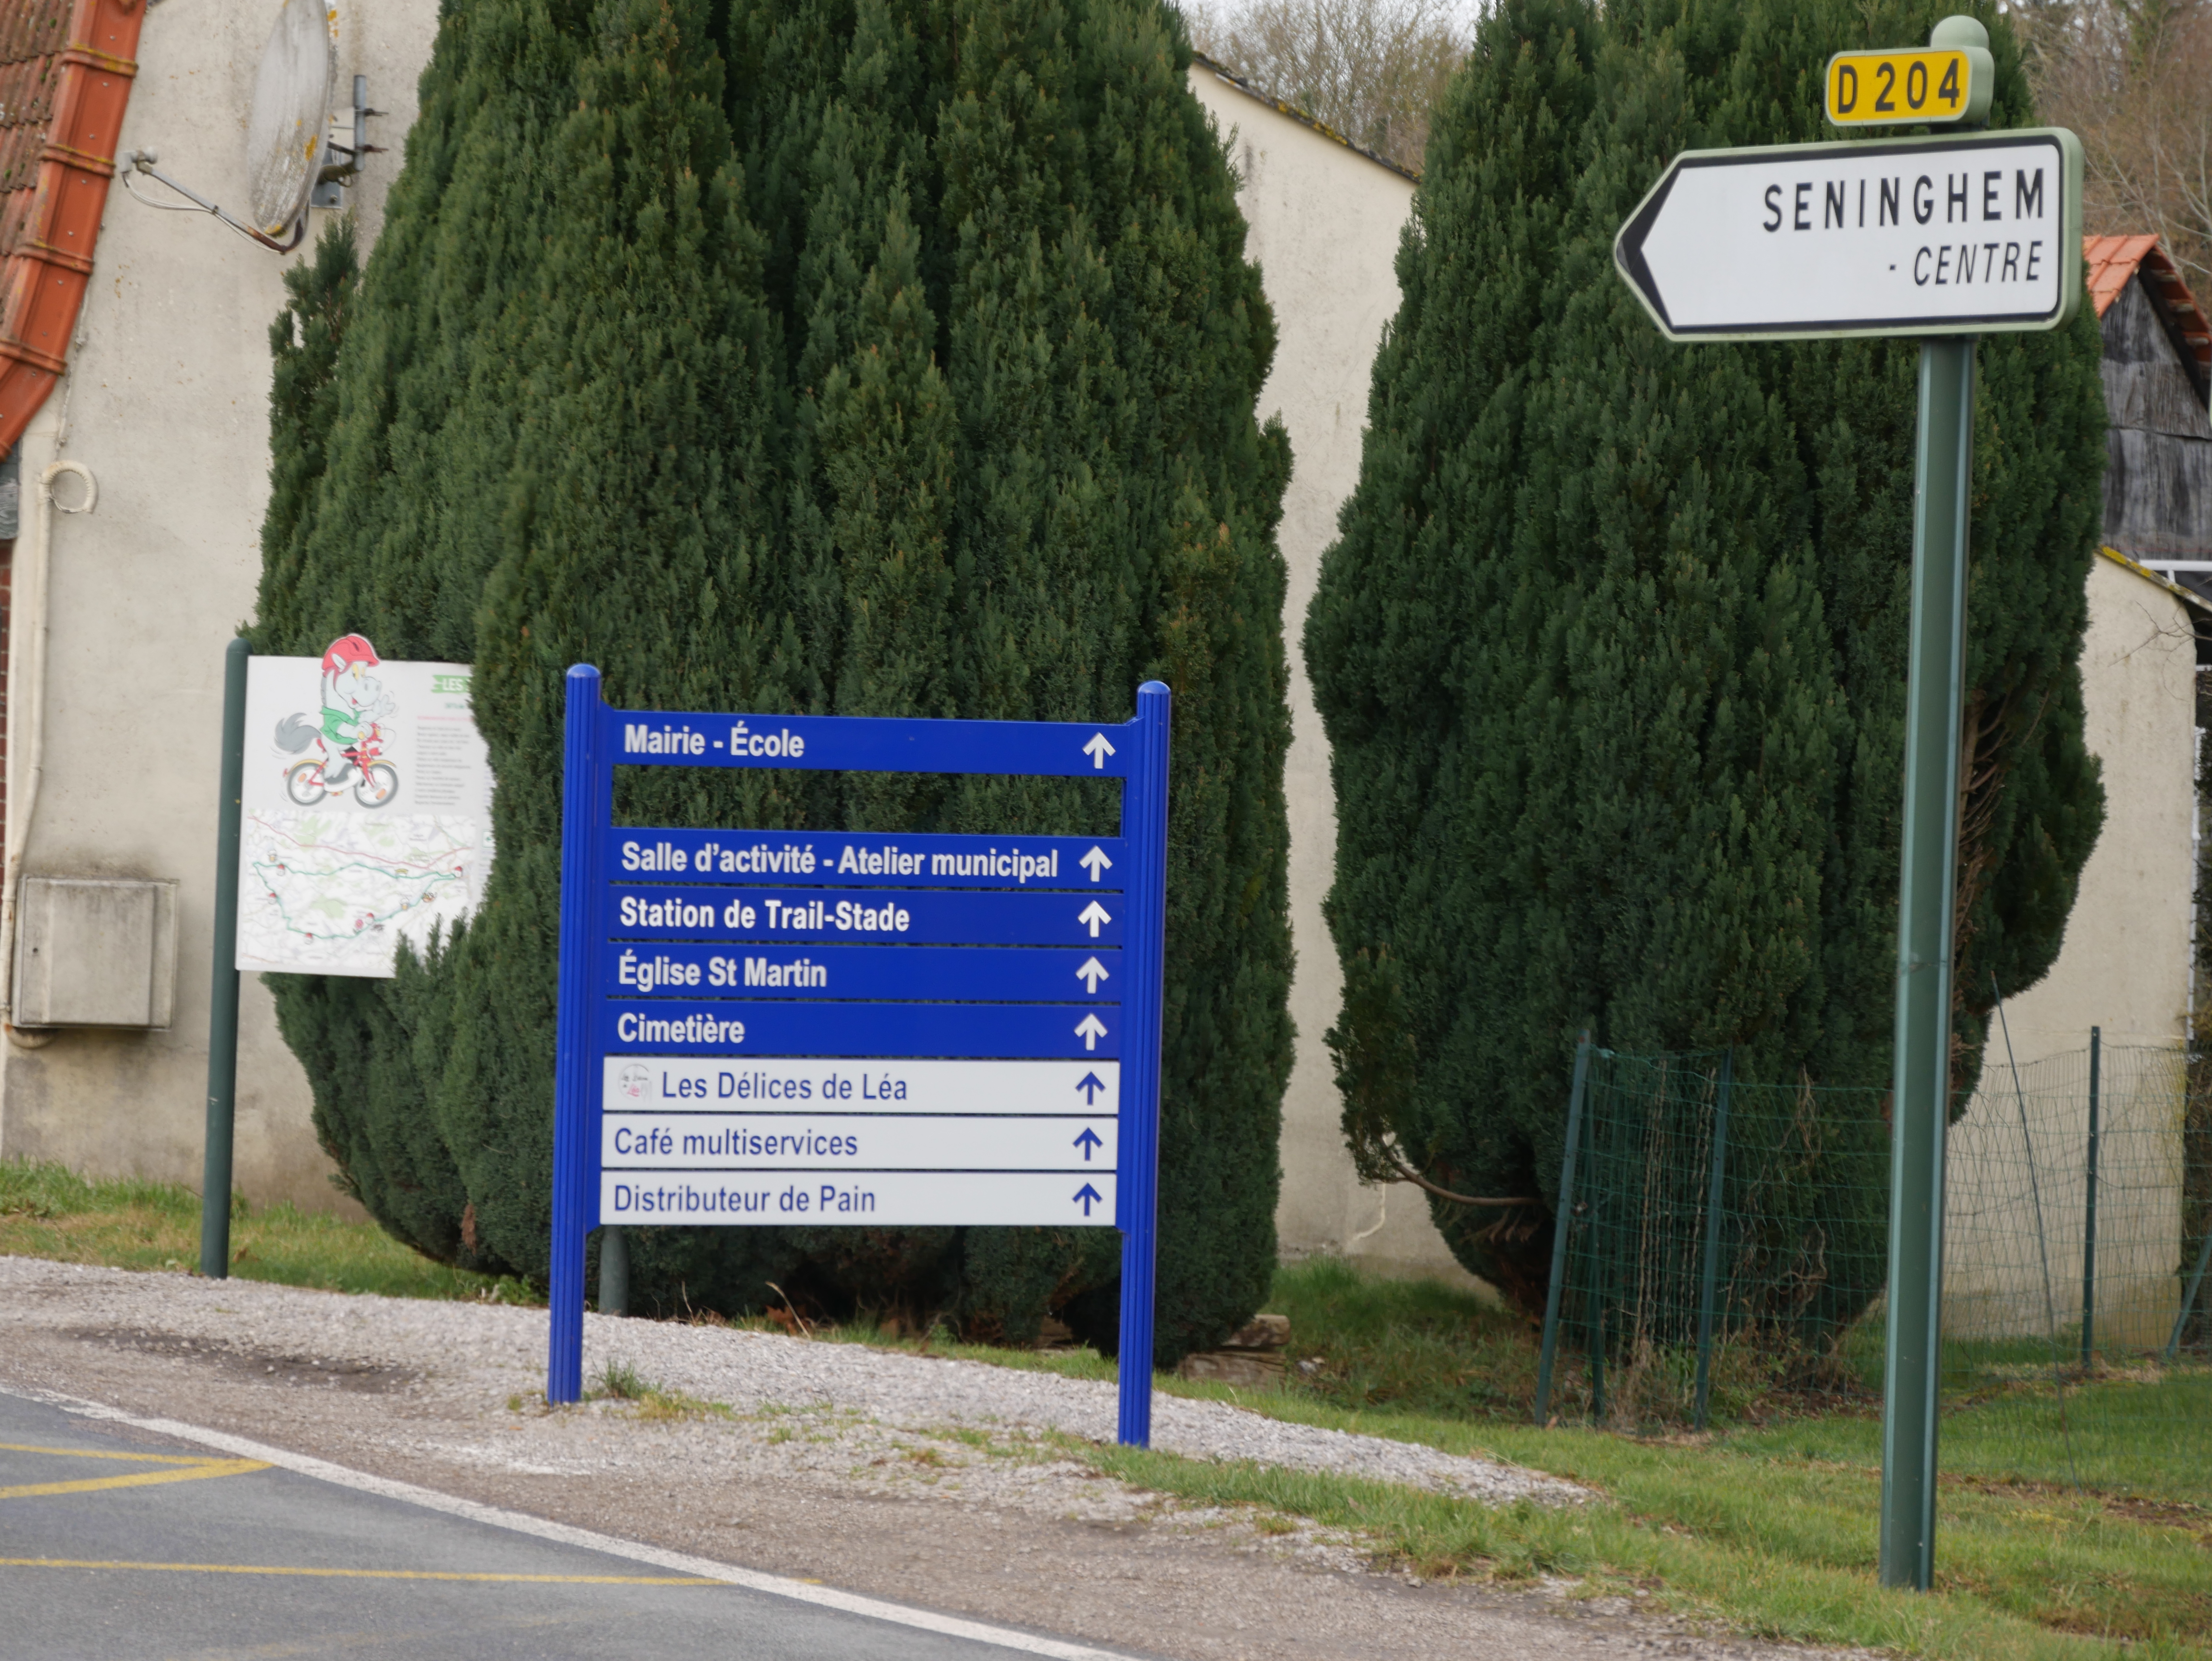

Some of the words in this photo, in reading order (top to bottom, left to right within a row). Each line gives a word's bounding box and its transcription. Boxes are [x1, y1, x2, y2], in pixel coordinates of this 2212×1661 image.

[1838, 65, 1857, 114] D
[1875, 59, 1959, 112] 204
[1763, 168, 2043, 232] SENINGHEM
[1914, 240, 2042, 286] CENTRE
[443, 678, 463, 691] LES
[624, 724, 706, 755] Mairie
[730, 720, 804, 758] École
[621, 841, 688, 871] Salle
[695, 843, 816, 874] d'activité
[837, 845, 926, 875] Atelier
[932, 848, 1058, 883] municipal
[619, 896, 715, 928] Station
[724, 899, 756, 929] de
[764, 899, 910, 932] Trail-Stade
[619, 949, 701, 992] Église
[708, 956, 737, 987] St
[744, 957, 827, 987] Martin
[618, 1012, 745, 1043] Cimetière
[663, 1071, 707, 1098] Les
[718, 1072, 812, 1099] Délices
[822, 1073, 852, 1099] de
[863, 1073, 907, 1100] Léa
[615, 1127, 673, 1155] Café
[683, 1128, 857, 1156] multiservices
[615, 1185, 771, 1212] Distributeur
[779, 1185, 809, 1212] de
[820, 1185, 875, 1212] Pain
